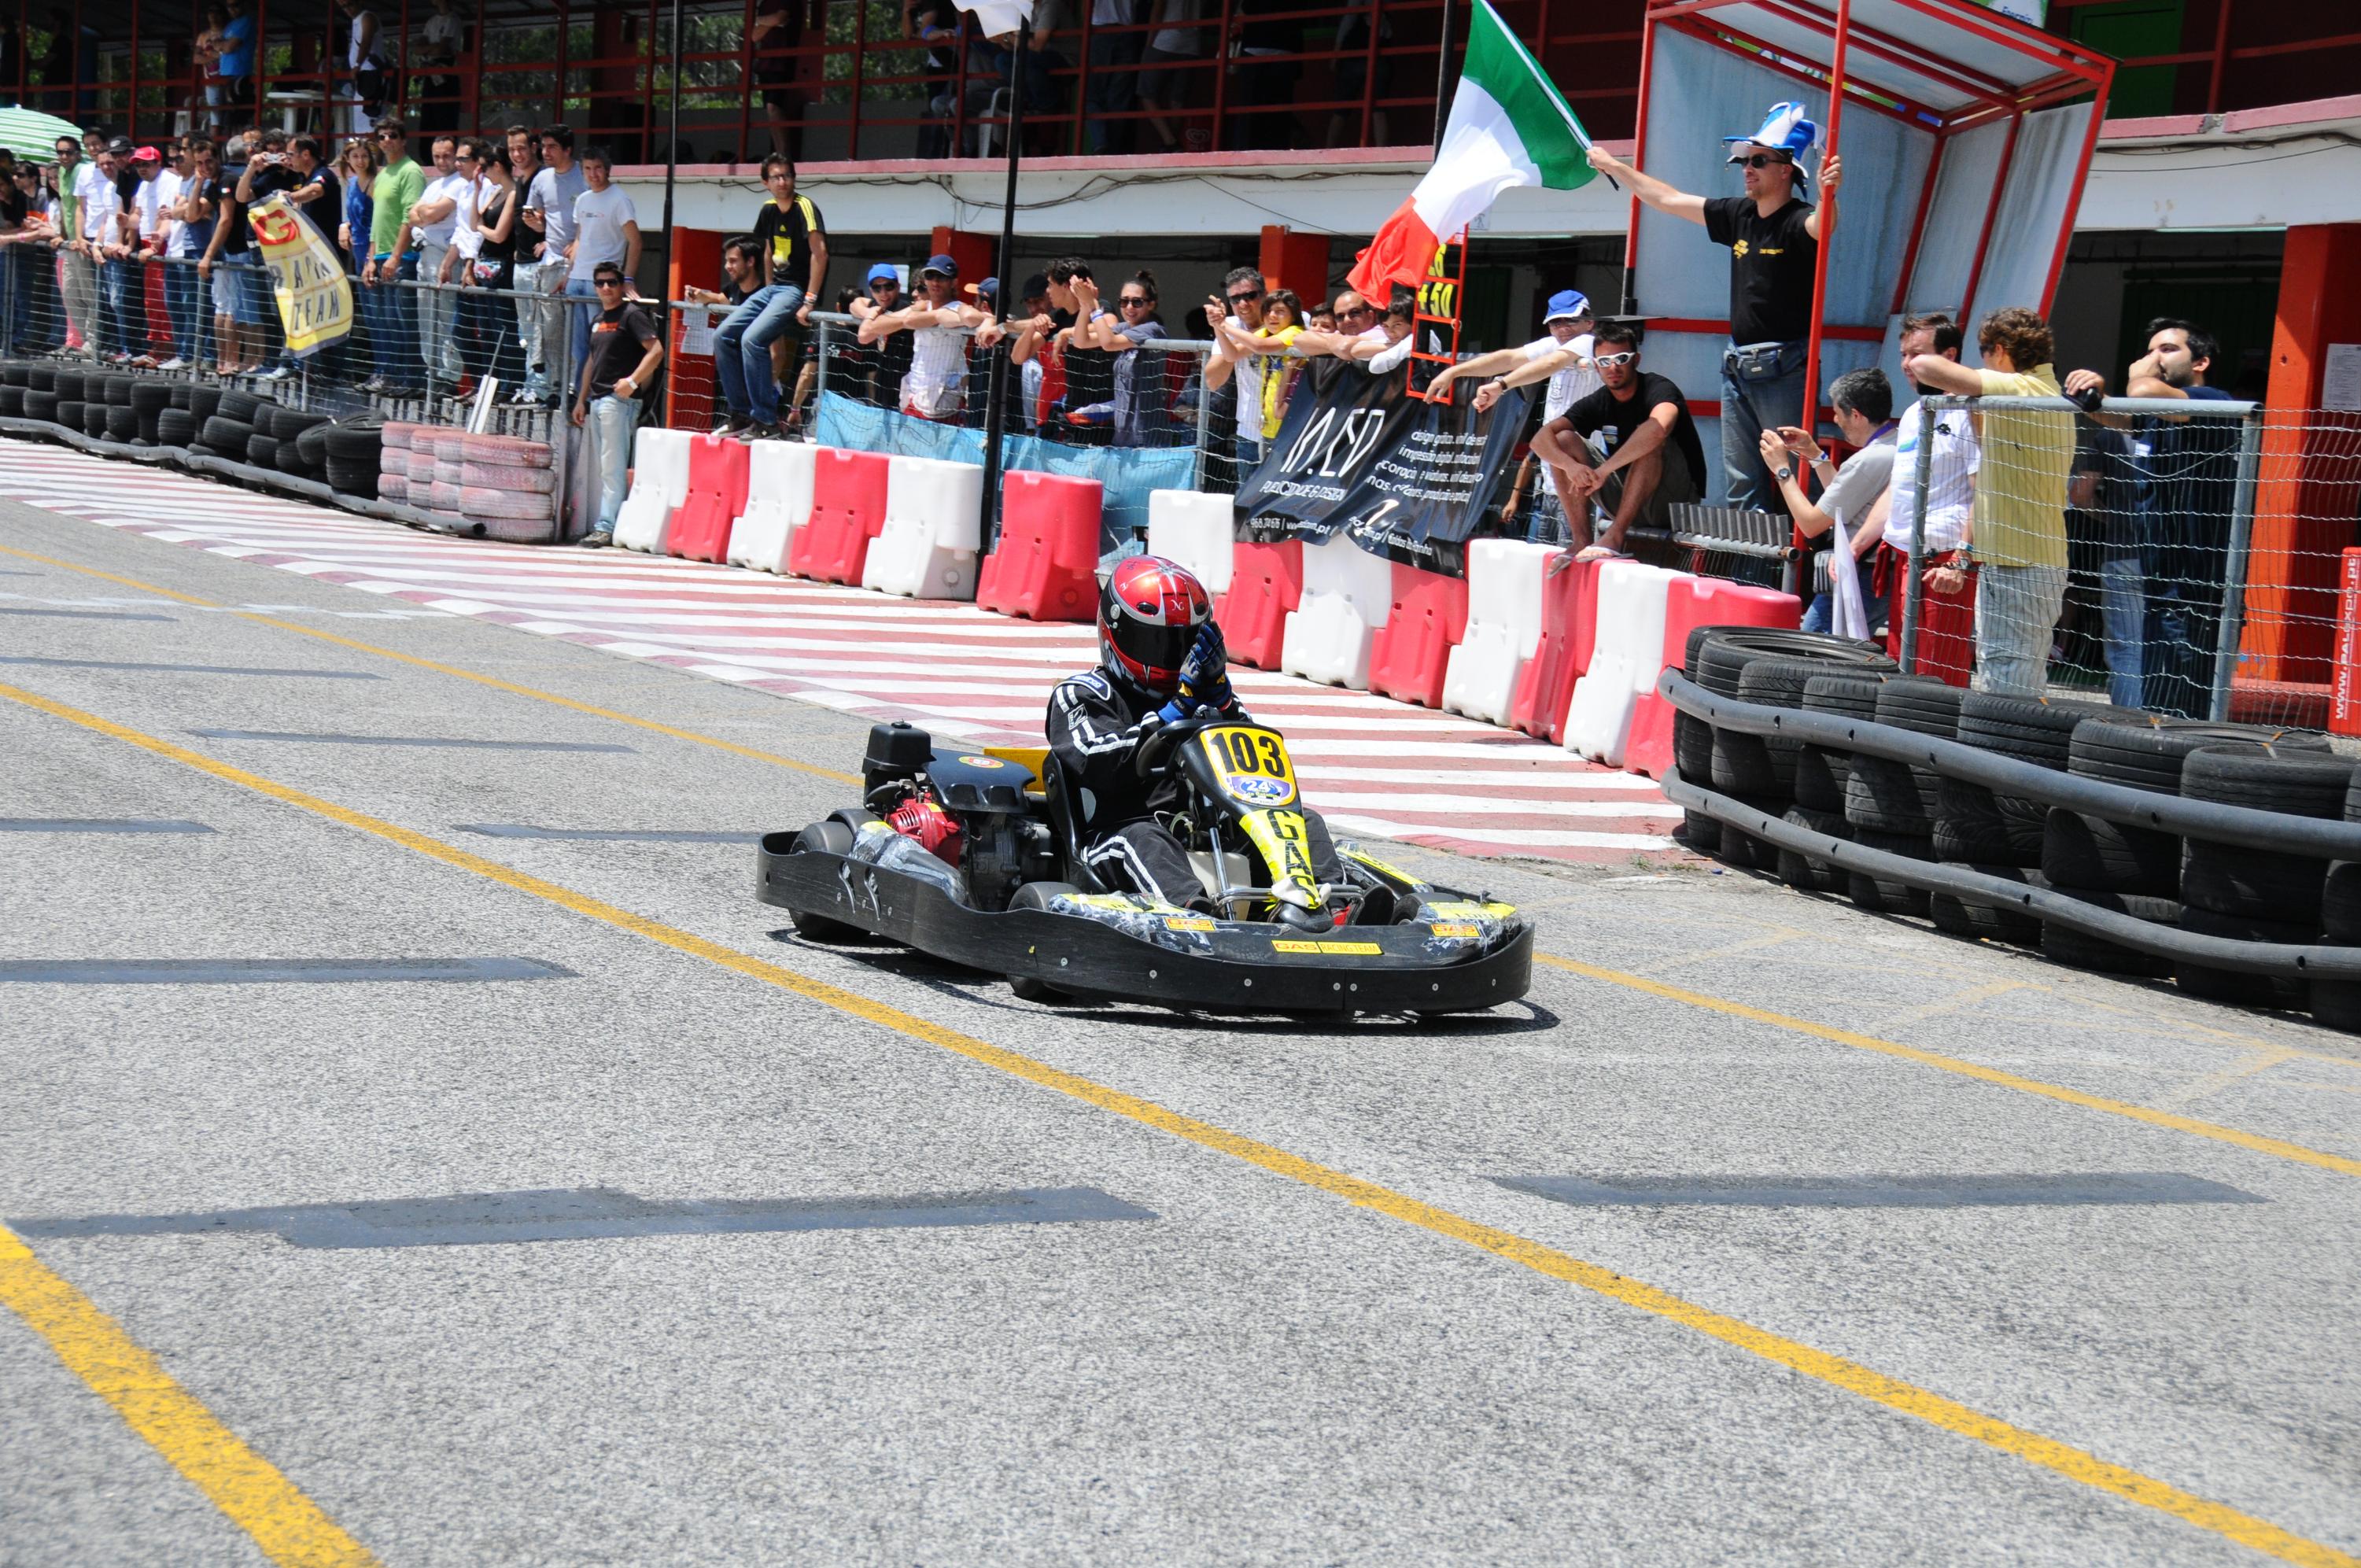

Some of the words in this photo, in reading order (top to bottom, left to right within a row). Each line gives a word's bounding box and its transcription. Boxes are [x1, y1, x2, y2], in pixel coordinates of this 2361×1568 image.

[291, 289, 340, 331] TEAM
[1209, 732, 1286, 778] 103
[1266, 809, 1320, 907] GAS
[1321, 943, 1352, 953] RACING
[1353, 944, 1380, 954] TEAM
